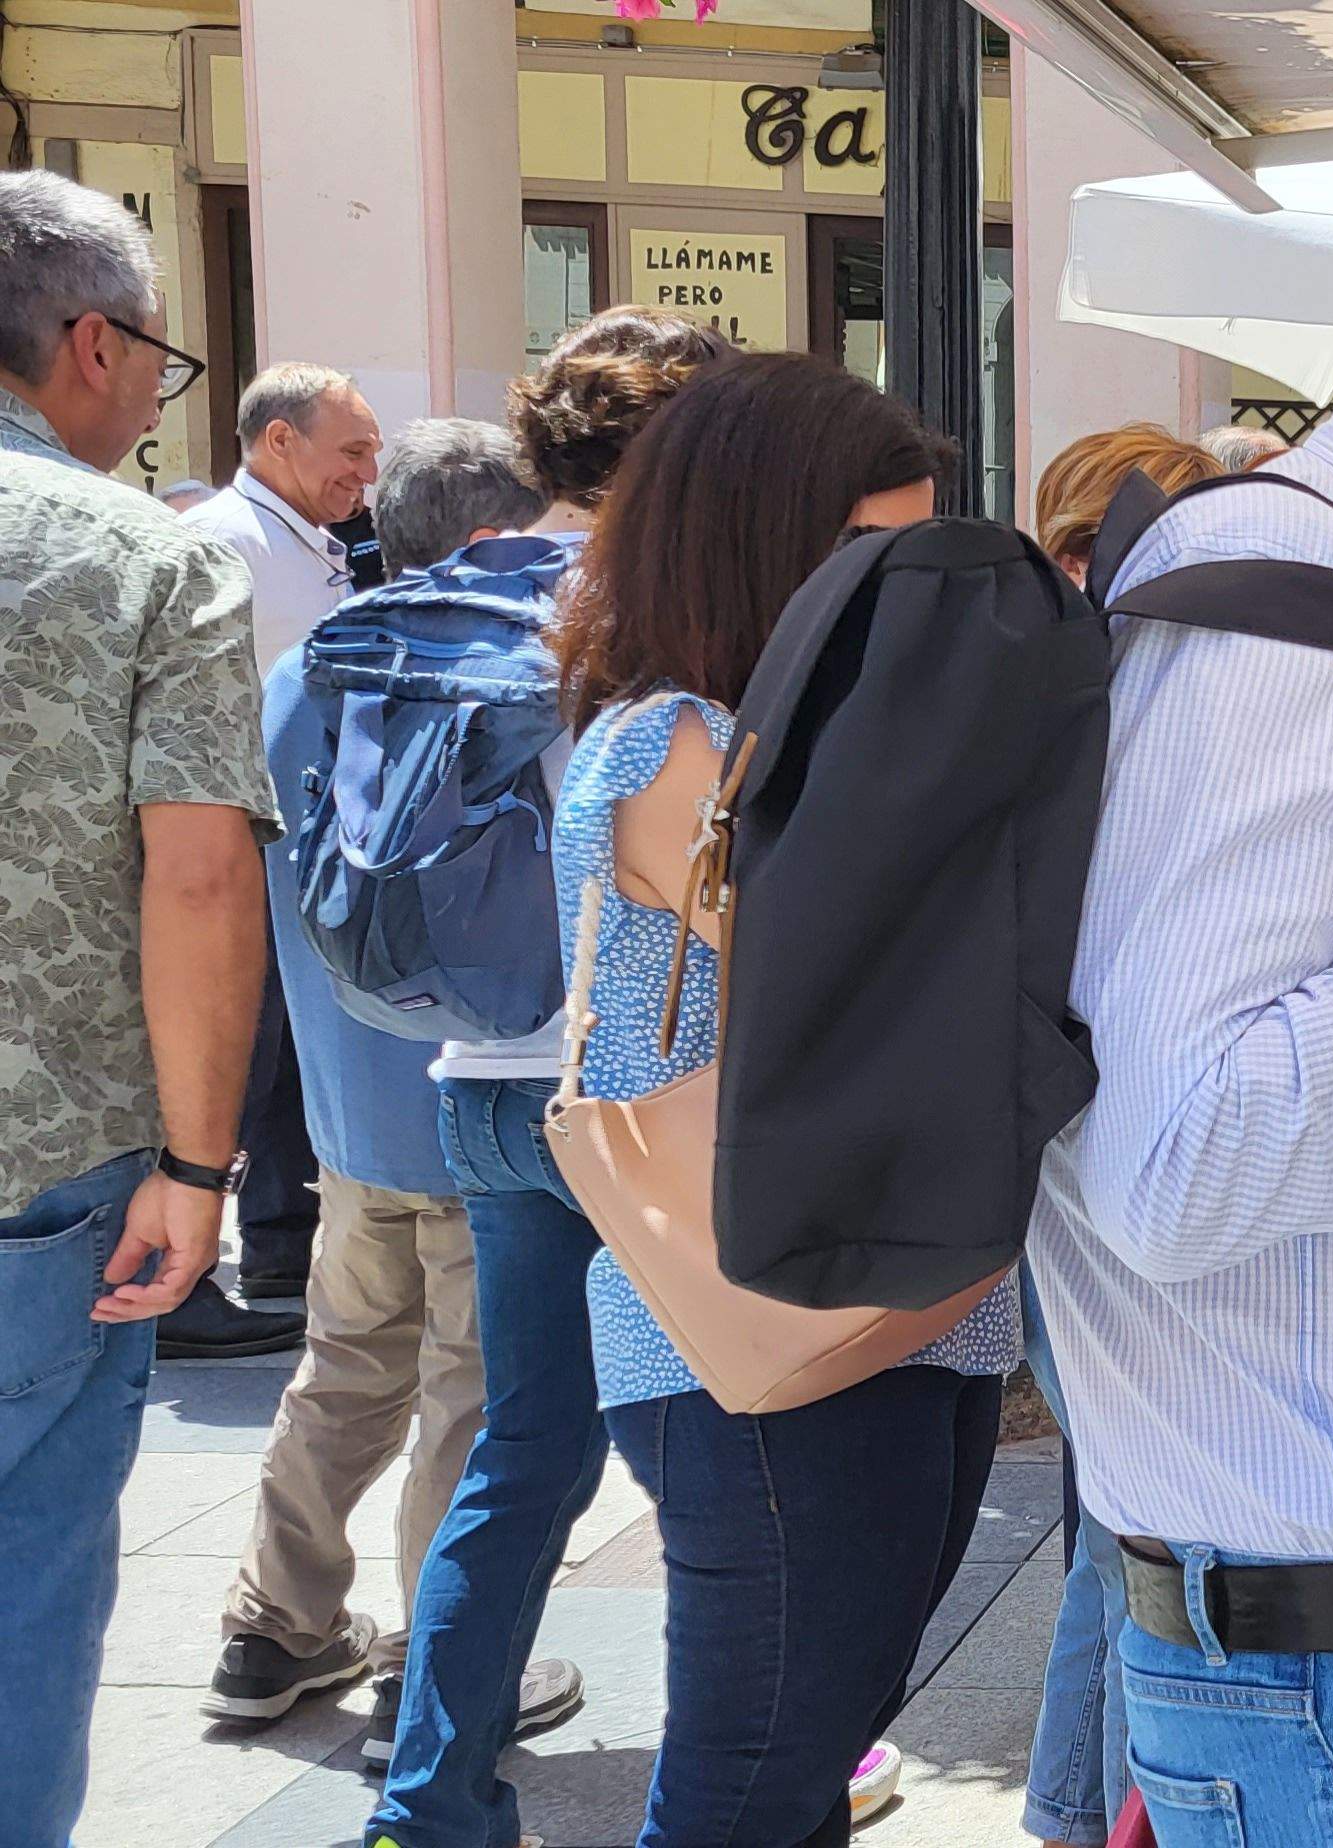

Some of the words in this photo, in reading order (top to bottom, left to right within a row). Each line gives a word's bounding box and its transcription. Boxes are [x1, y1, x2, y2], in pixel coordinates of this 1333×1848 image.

[741, 84, 877, 167] Ca
[646, 240, 774, 275] LLÁMAME
[658, 285, 724, 306] PERO
